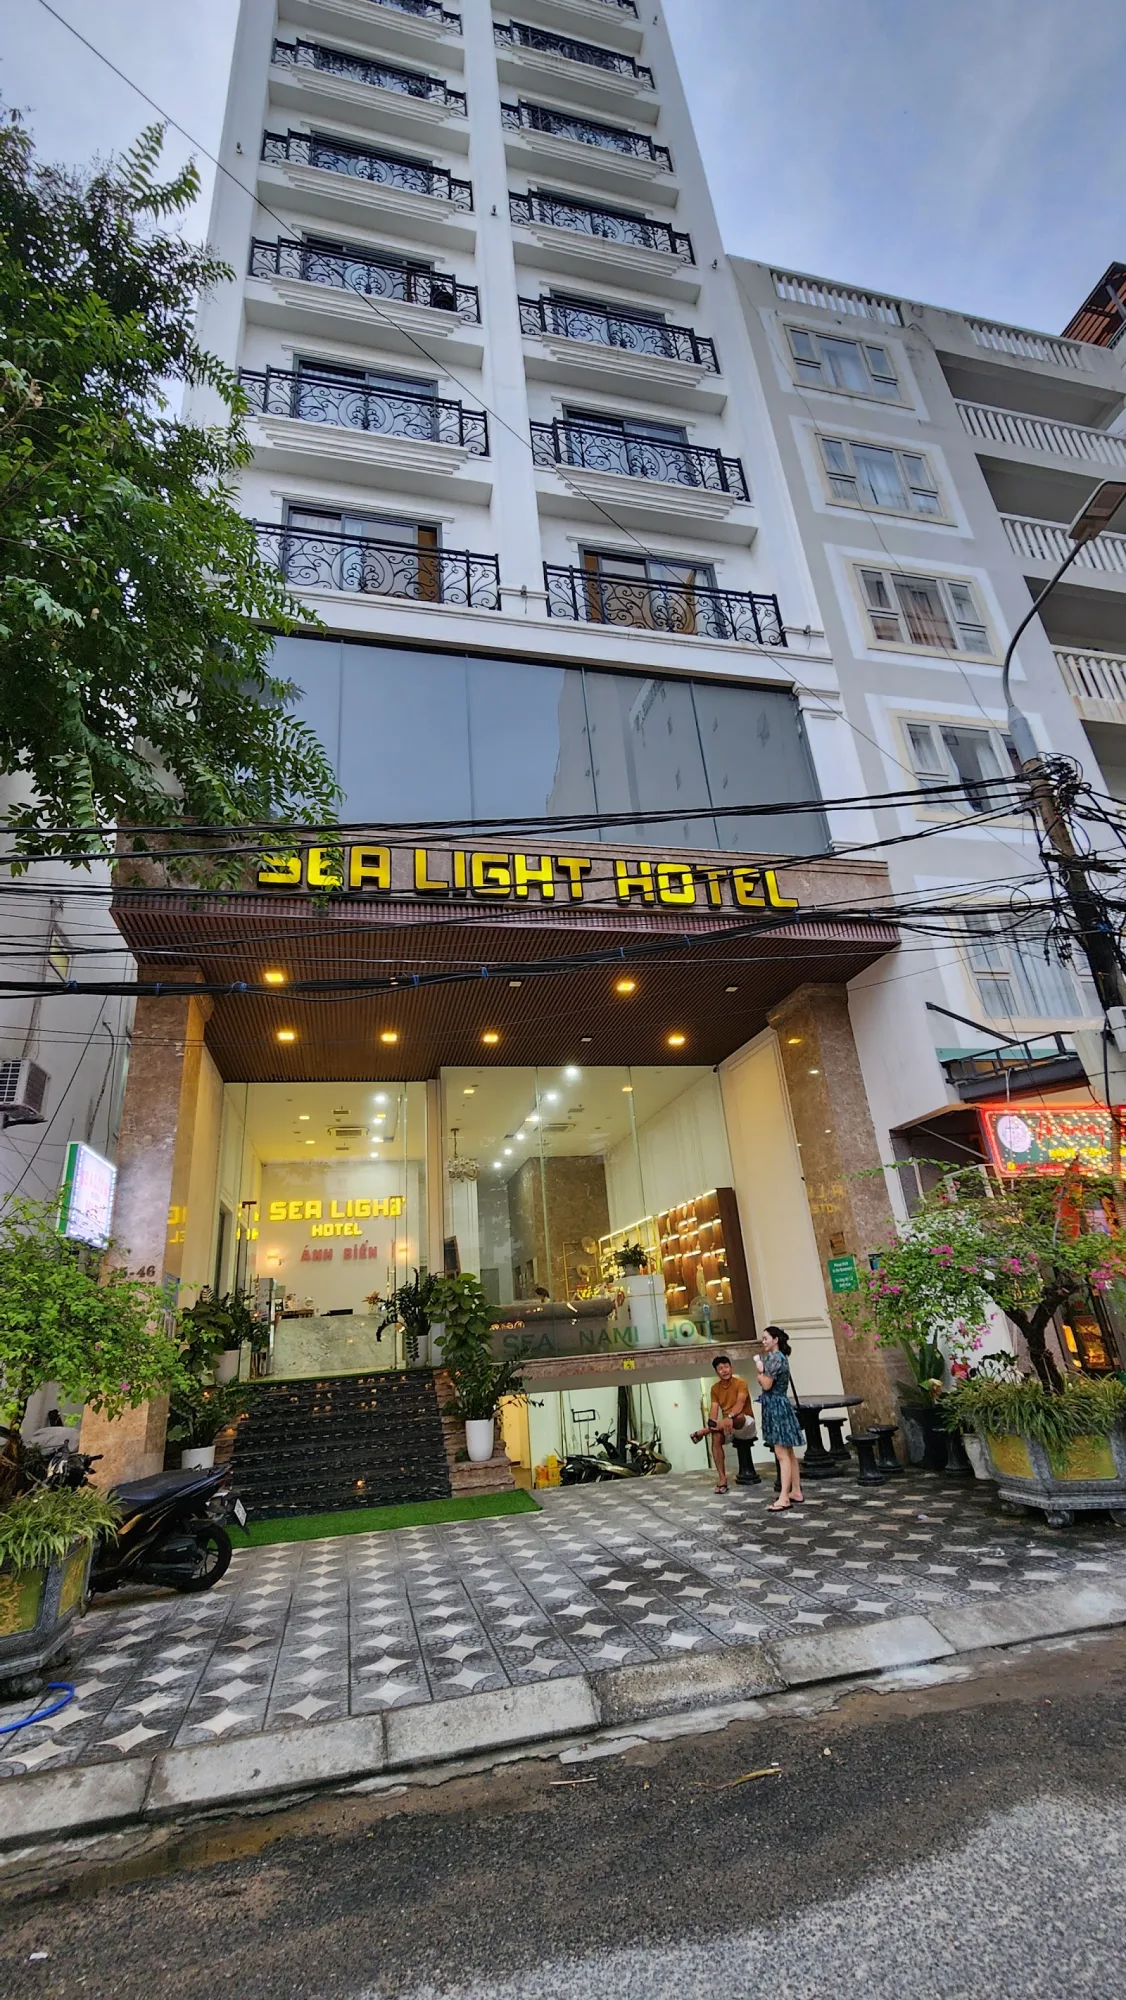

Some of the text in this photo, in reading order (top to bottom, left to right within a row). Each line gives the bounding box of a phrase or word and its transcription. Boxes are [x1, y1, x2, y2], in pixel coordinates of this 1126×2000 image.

[258, 845, 799, 908] SEA LIGHT HOTEL
[269, 1197, 405, 1221] SEA LIGHT
[311, 1223, 363, 1238] HOTEL
[503, 1319, 738, 1353] SEA NAMI HOTEL
